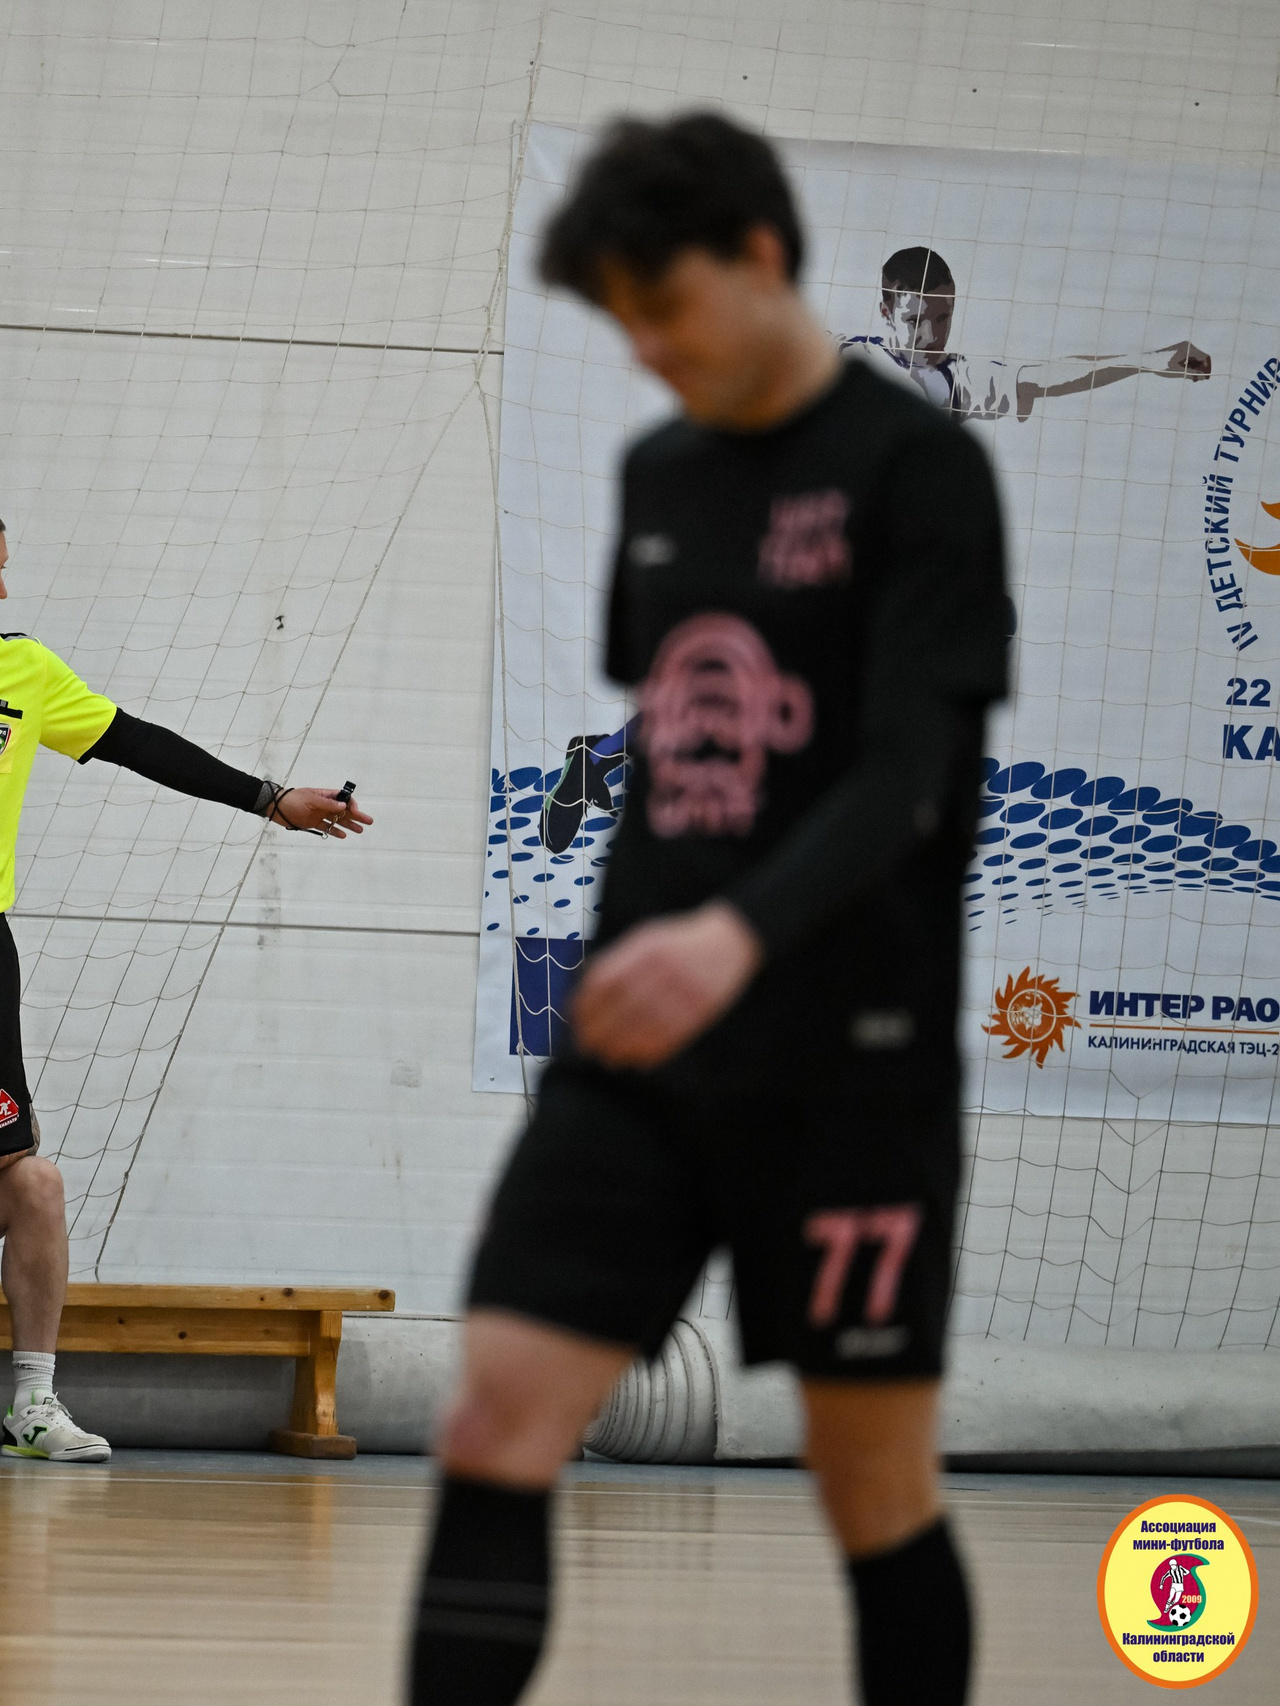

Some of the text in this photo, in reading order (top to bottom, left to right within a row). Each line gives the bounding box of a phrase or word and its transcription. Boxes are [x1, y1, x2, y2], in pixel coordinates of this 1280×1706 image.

[1202, 474, 1247, 612] ДЕТСКИЙ
[1225, 678, 1271, 707] 22
[1089, 991, 1280, 1022] ИНТЕР РАО
[1088, 1036, 1279, 1057] КАЛИНИНГРАДСКАЯ ТЭЦ-2
[804, 1206, 922, 1330] 77
